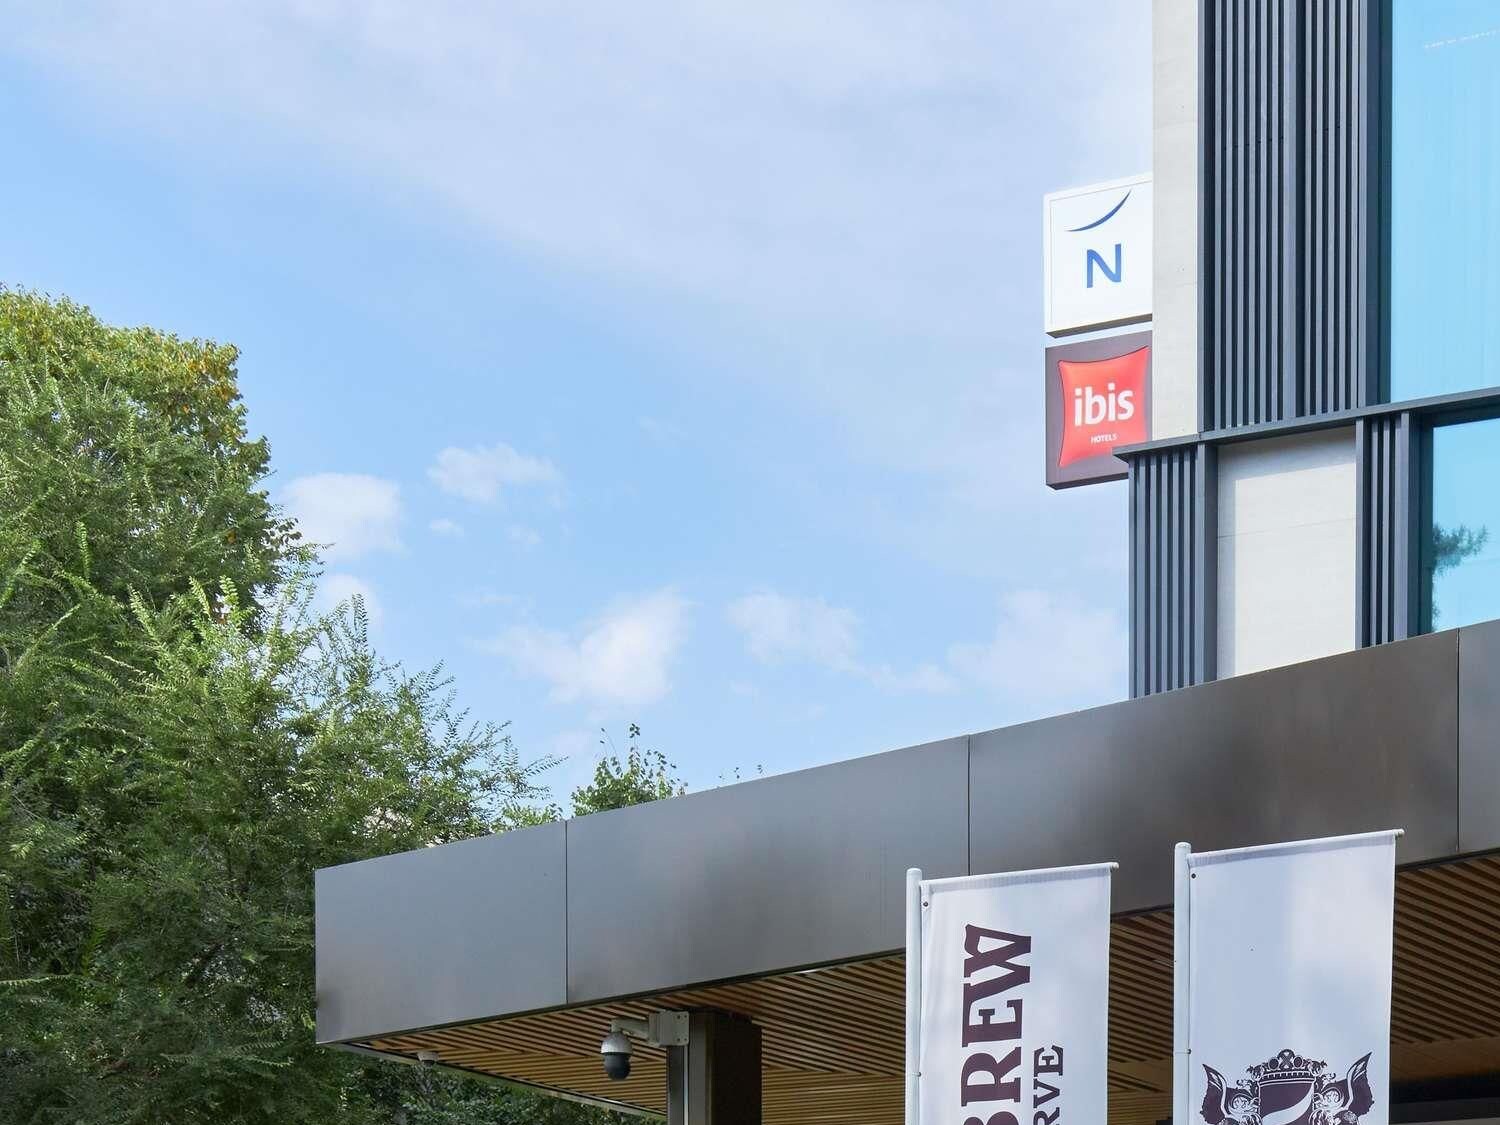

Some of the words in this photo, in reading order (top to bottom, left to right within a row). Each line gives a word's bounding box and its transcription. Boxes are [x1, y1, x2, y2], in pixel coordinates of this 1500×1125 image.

[1086, 243, 1122, 289] N
[1074, 382, 1135, 427] ibis
[1090, 432, 1118, 445] HOTELS
